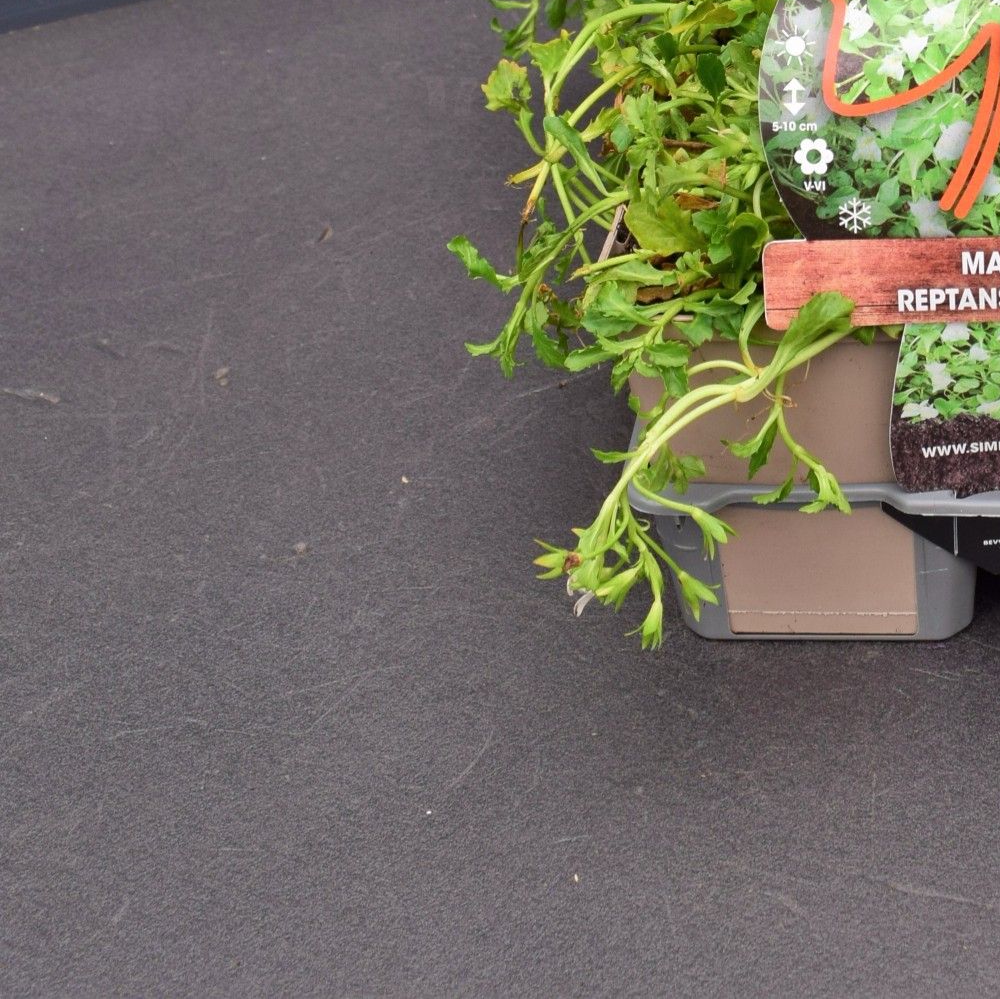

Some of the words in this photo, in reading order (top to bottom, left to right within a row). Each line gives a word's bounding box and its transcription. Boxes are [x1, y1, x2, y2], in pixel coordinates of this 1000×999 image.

[772, 121, 797, 132] 5-10
[799, 122, 818, 132] cm
[803, 180, 826, 191] V-VI
